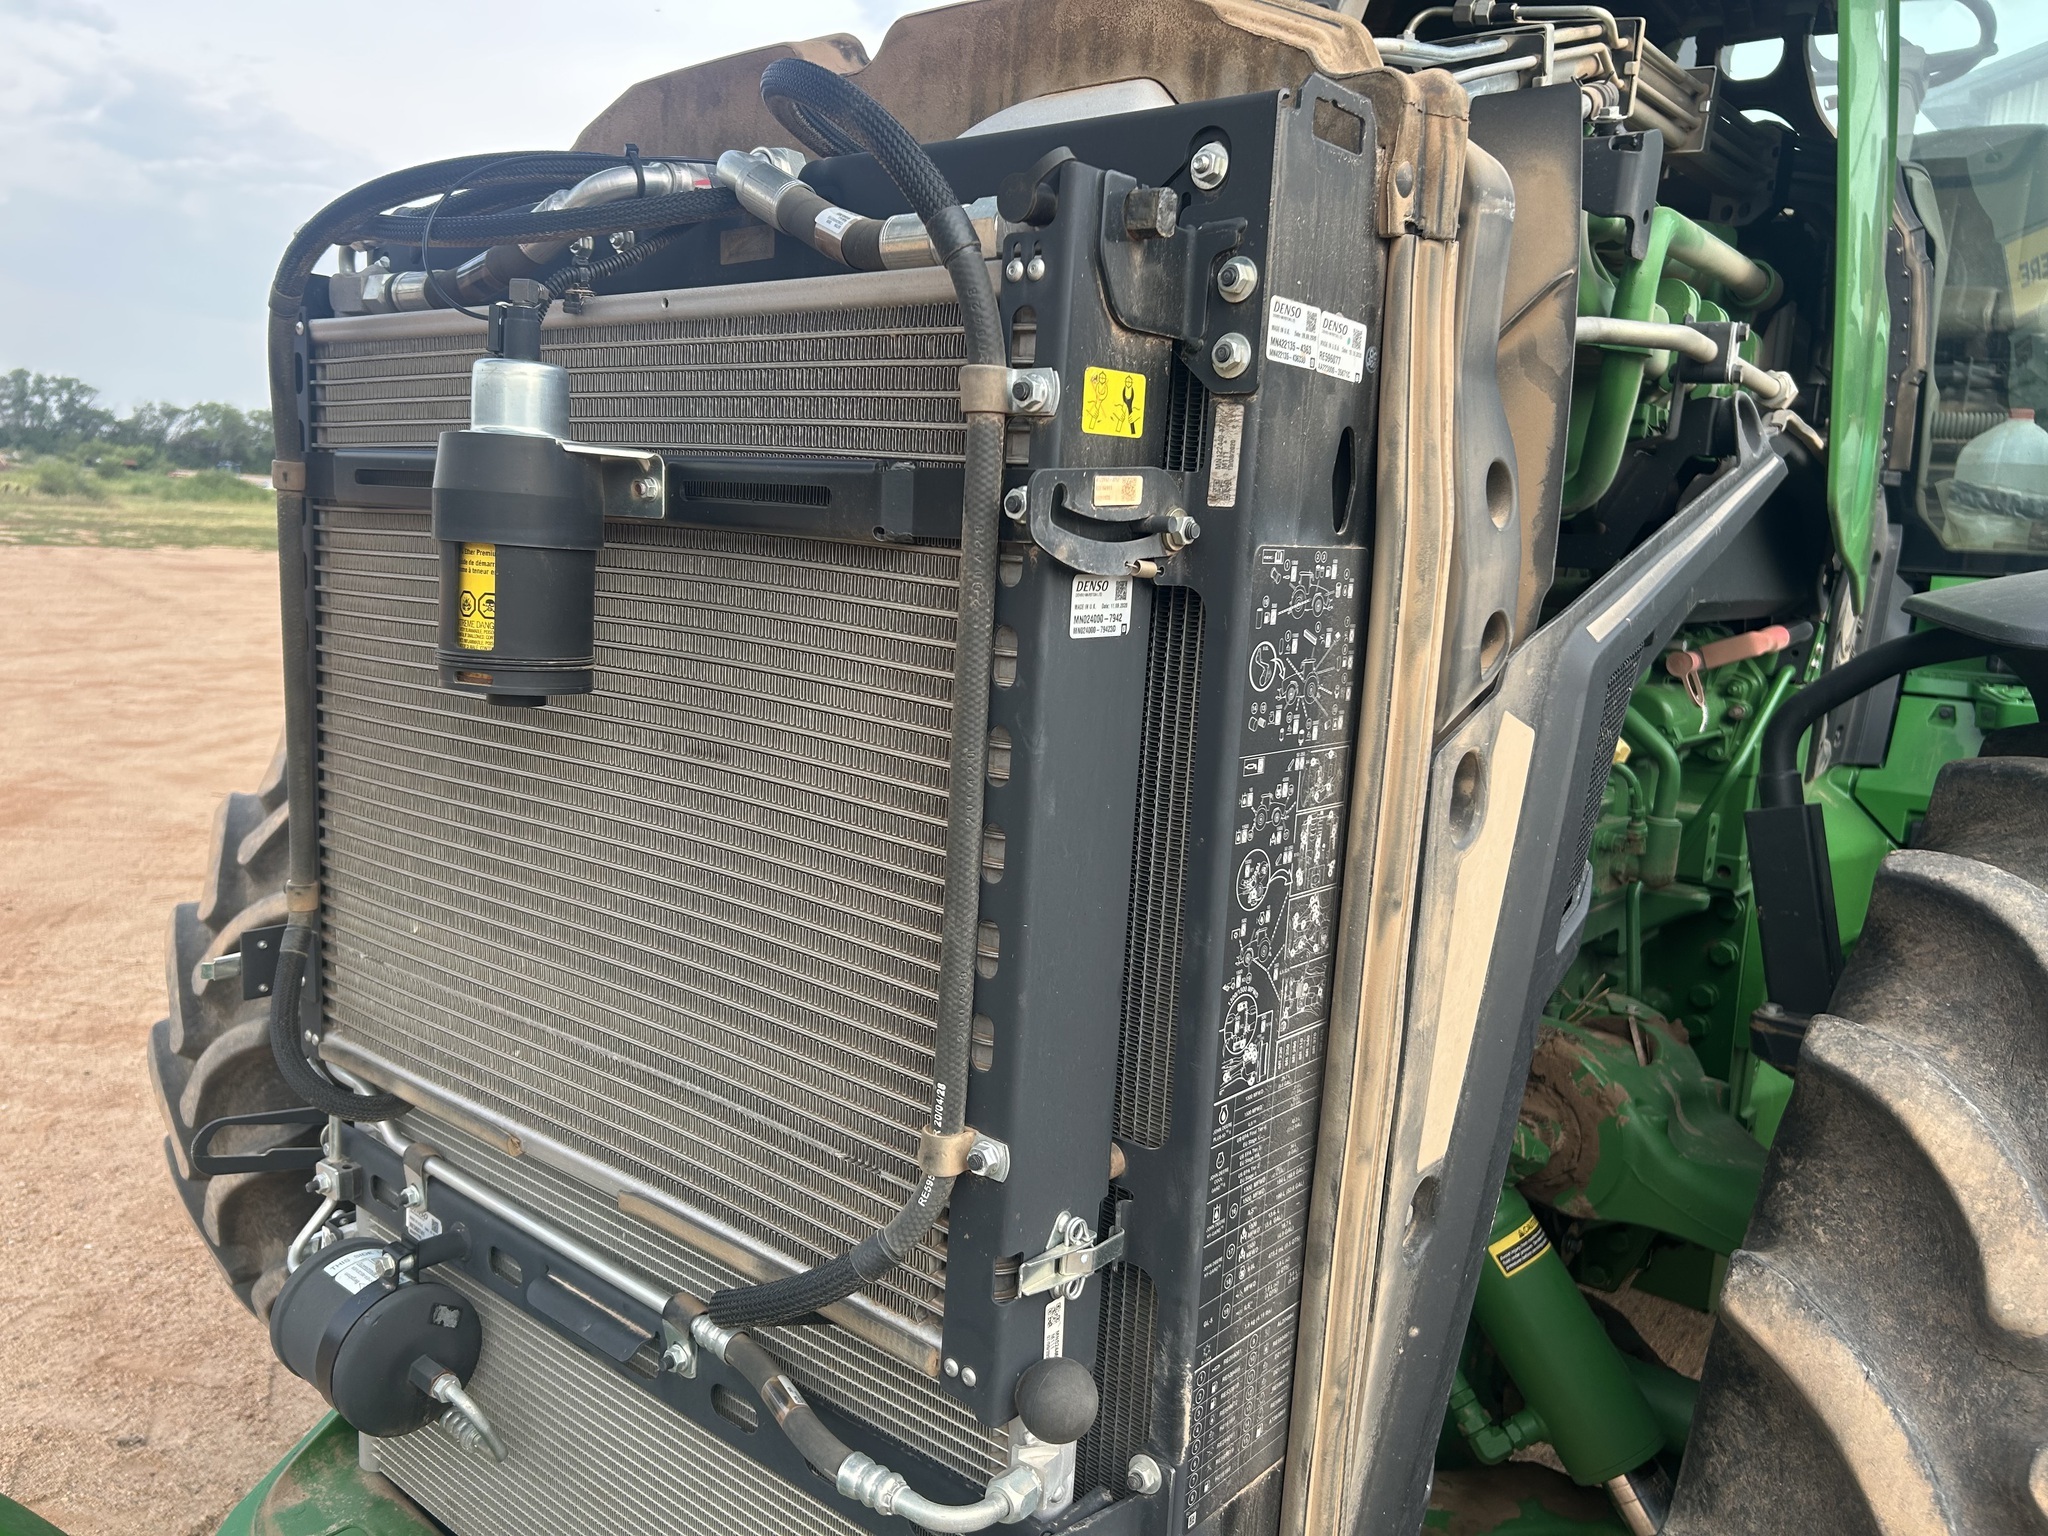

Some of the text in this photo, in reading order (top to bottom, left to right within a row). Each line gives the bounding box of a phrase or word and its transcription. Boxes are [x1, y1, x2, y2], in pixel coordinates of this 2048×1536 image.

[1274, 301, 1301, 318] DENSO
[1323, 318, 1348, 335] DENSO
[1076, 581, 1109, 592] DENSO
[330, 1259, 351, 1270] THIS
